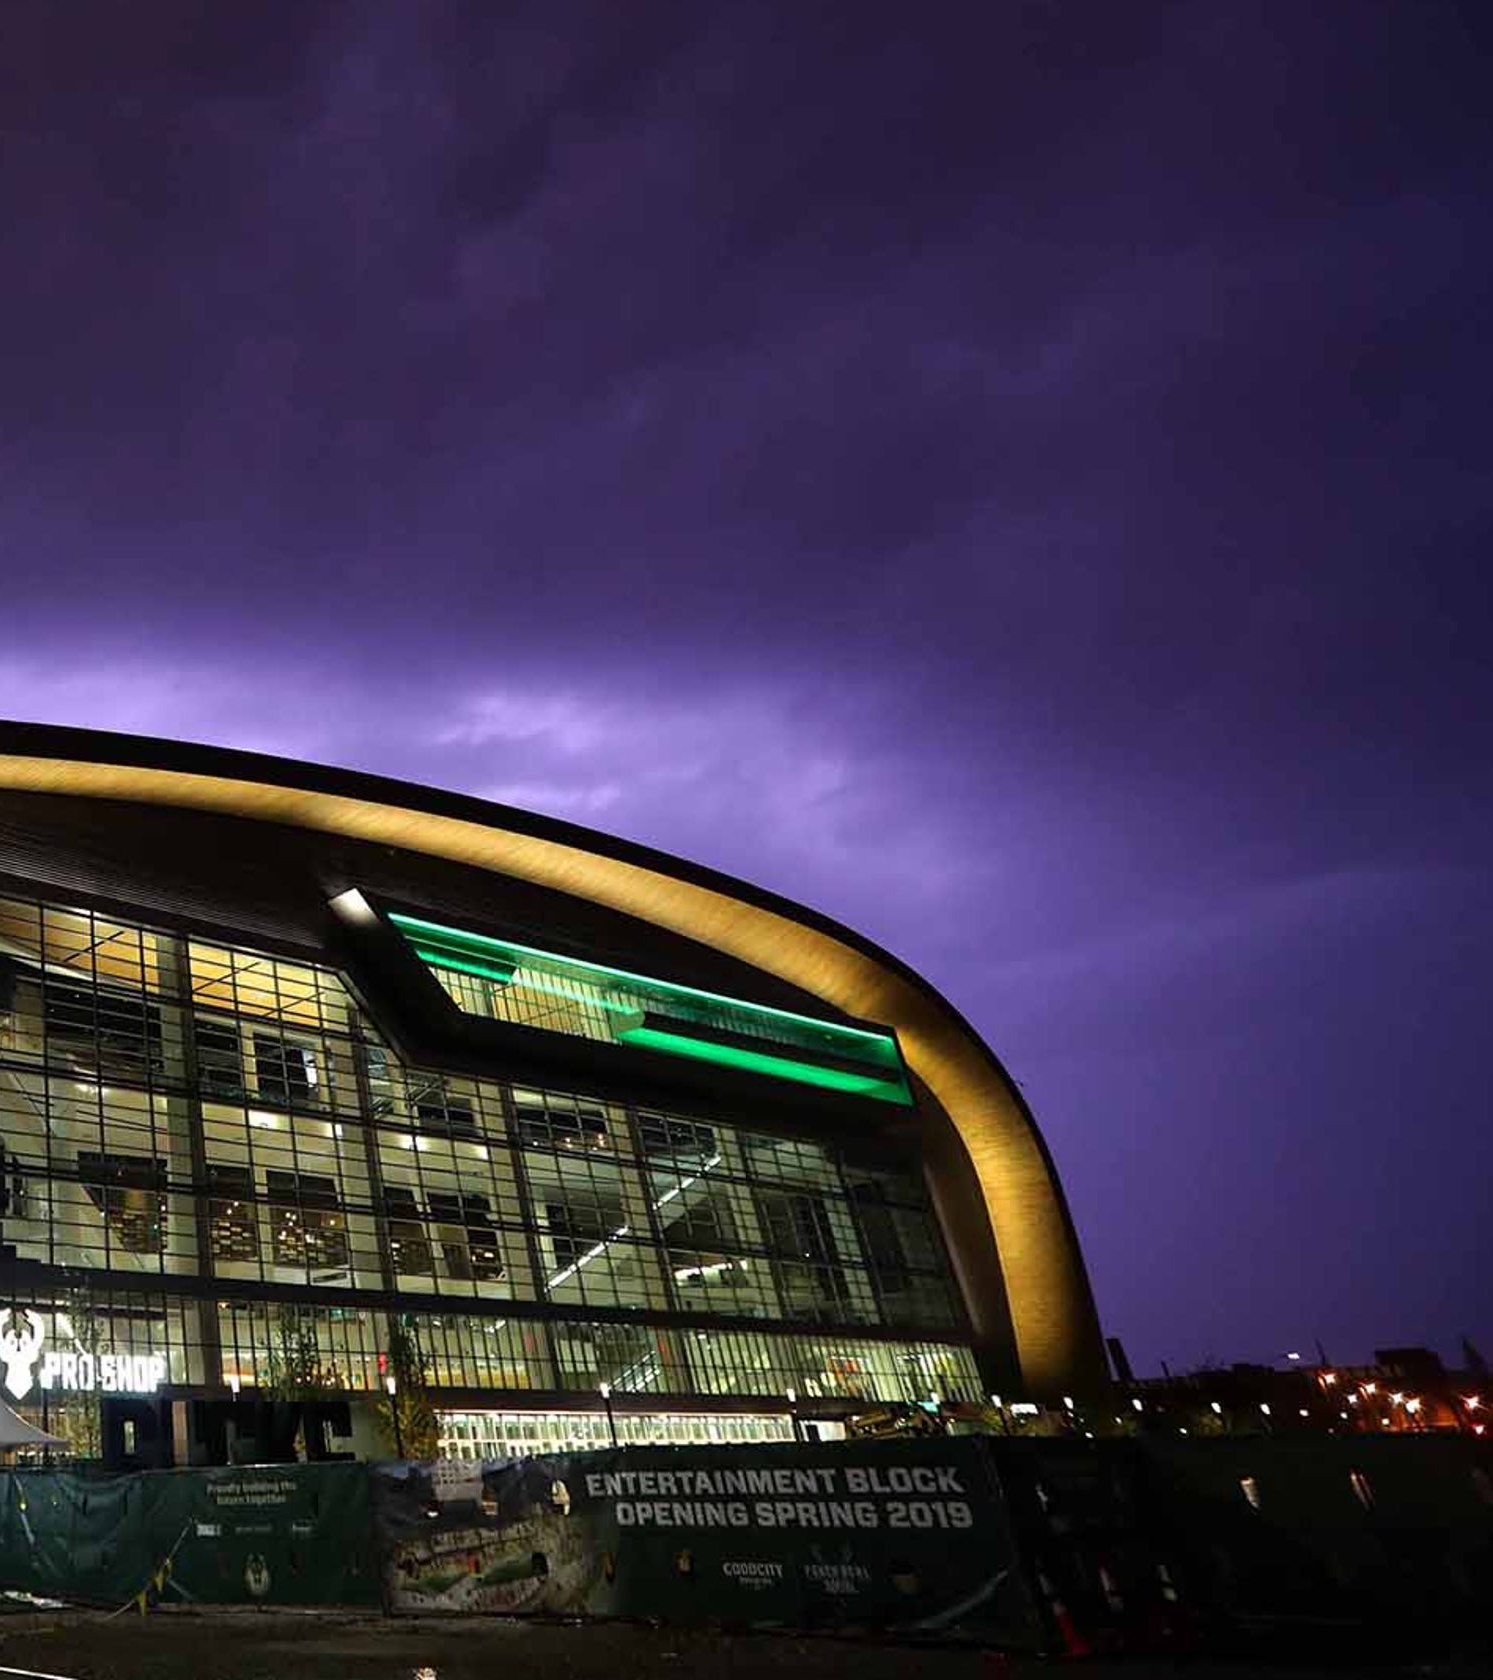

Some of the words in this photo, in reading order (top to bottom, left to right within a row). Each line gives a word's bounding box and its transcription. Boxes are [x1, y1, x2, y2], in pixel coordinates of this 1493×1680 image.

[40, 1352, 96, 1392] PRO
[99, 1353, 168, 1393] SHOP
[585, 1468, 837, 1498] ENTERTAINMENT
[846, 1466, 966, 1495] BLOCK
[615, 1500, 754, 1527] OPENING
[755, 1500, 879, 1528] SPRING
[887, 1501, 974, 1529] 2019
